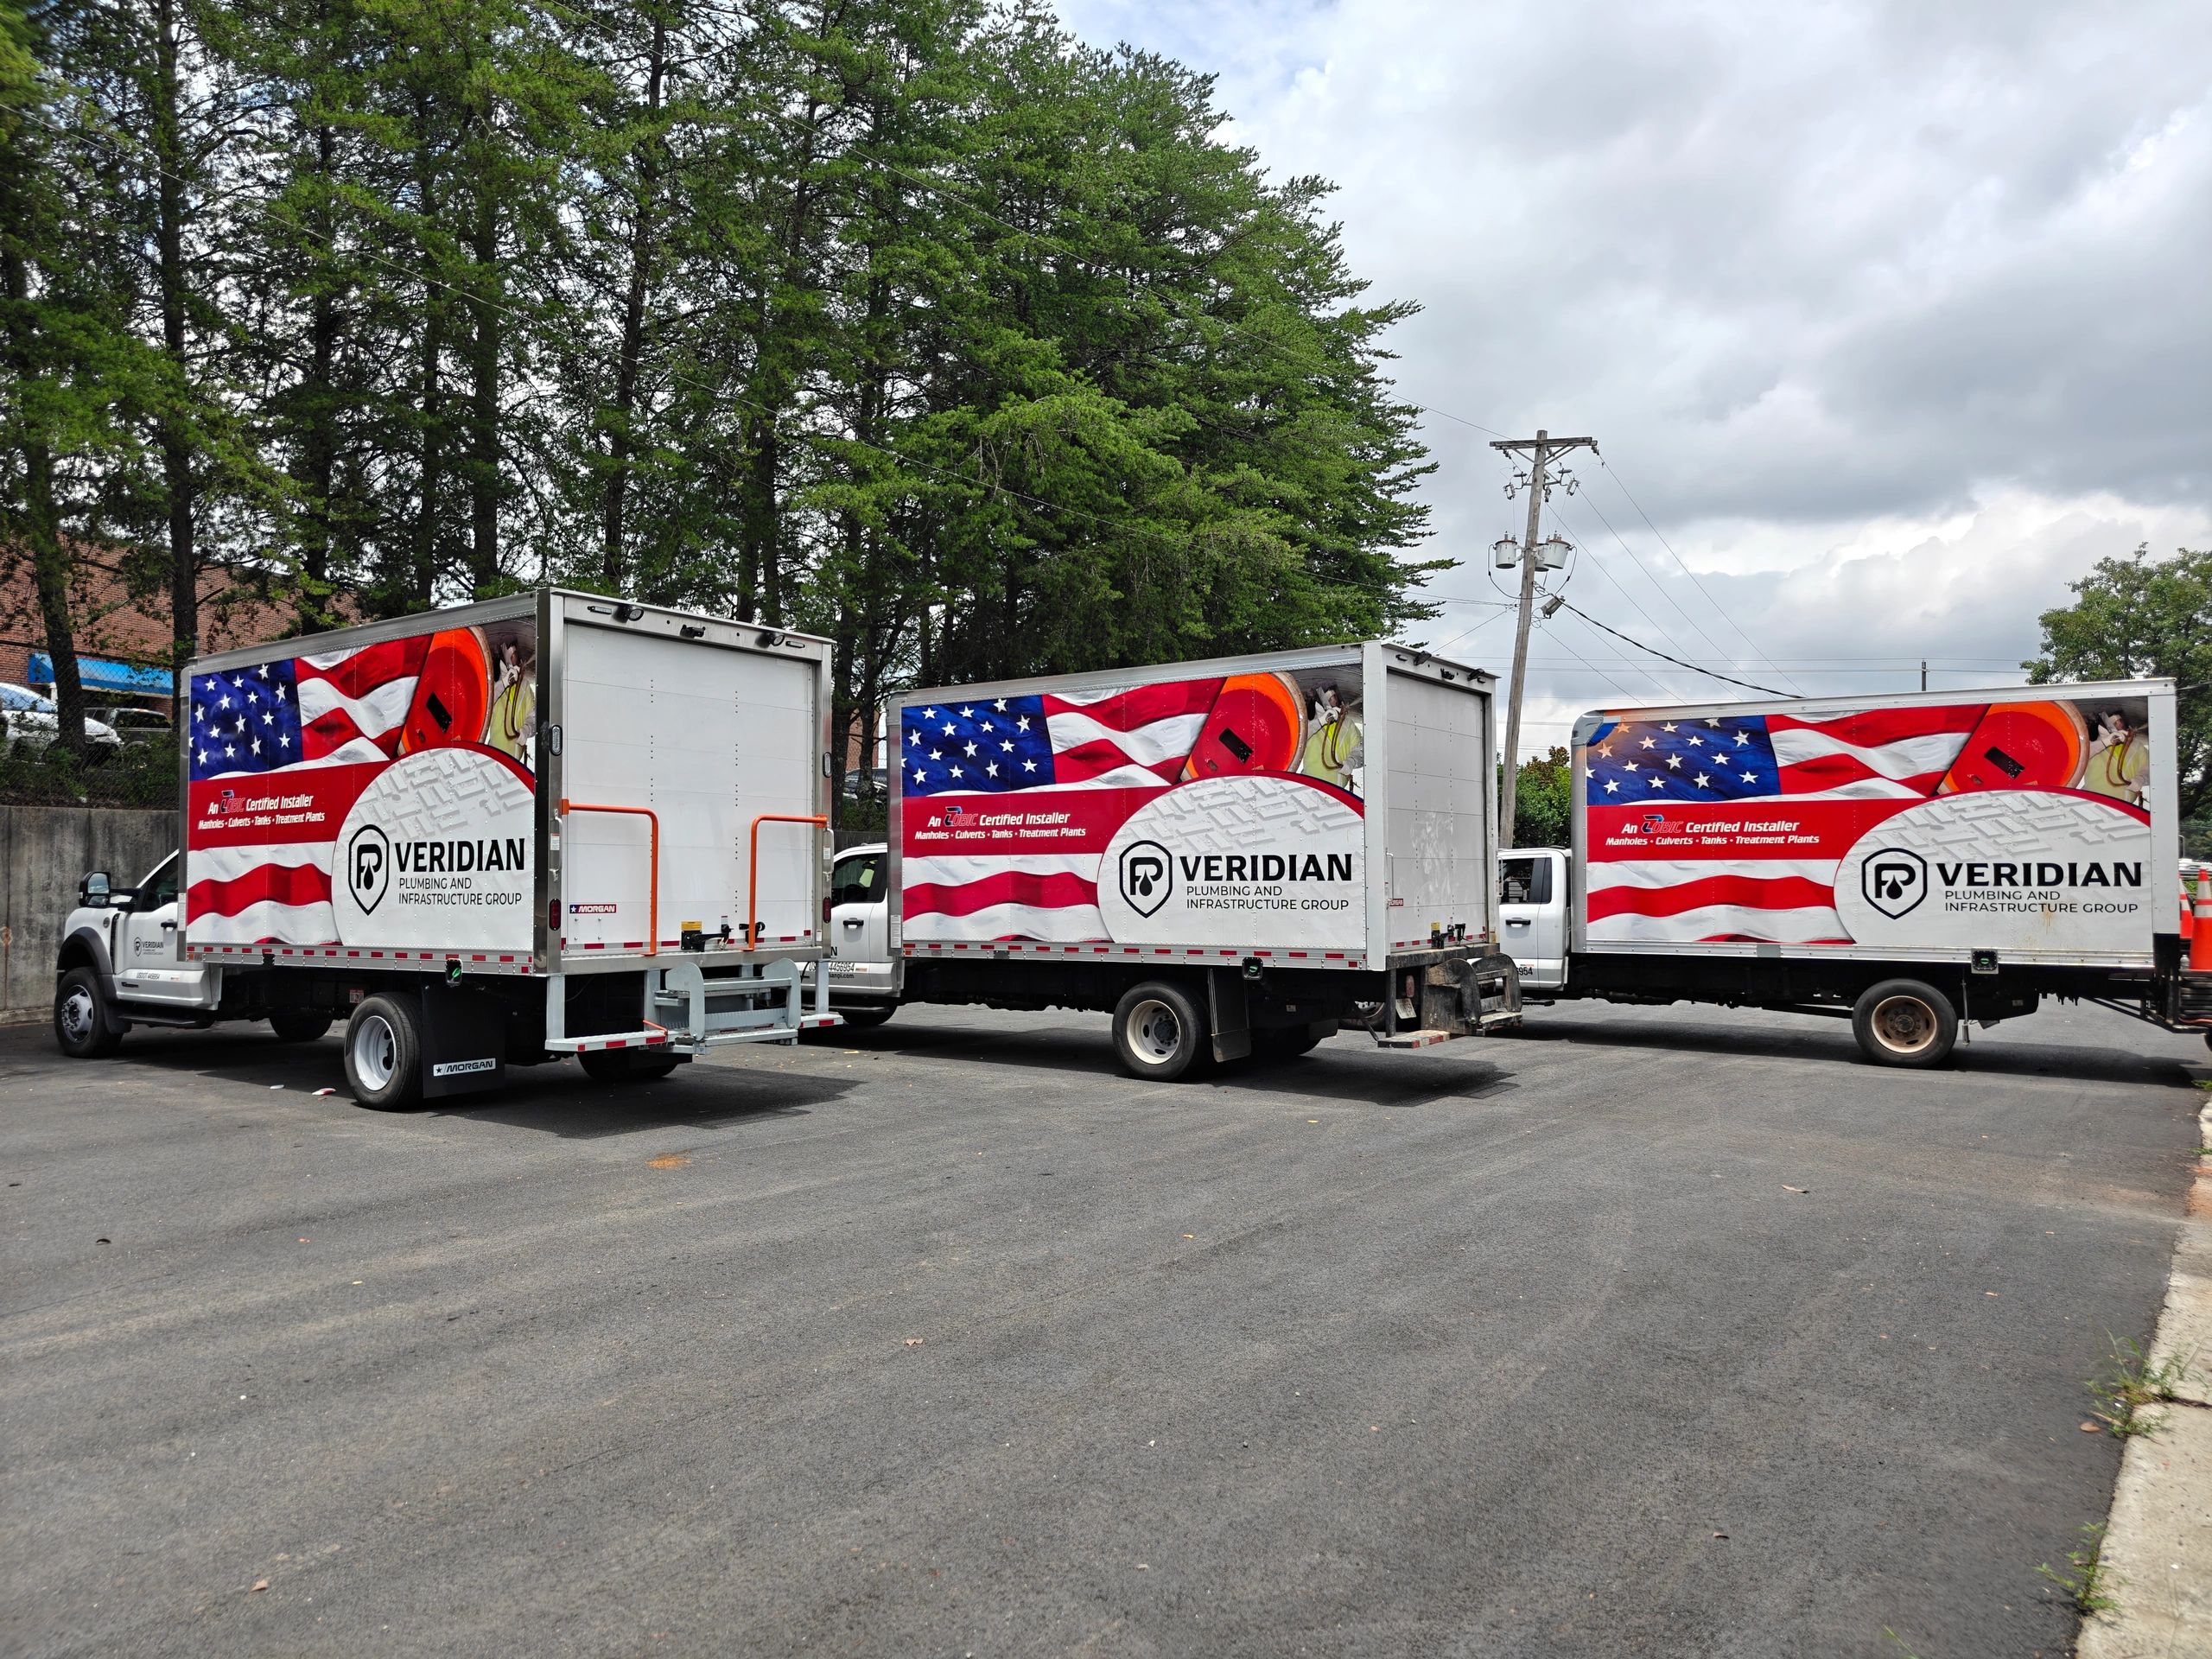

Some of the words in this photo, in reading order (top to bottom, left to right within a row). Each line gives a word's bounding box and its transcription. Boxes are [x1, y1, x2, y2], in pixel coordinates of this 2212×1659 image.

[207, 802, 219, 815] An
[246, 796, 279, 812] Certified
[281, 793, 314, 810] Installer
[198, 820, 225, 830] Manholes
[228, 817, 251, 828] Culverts
[254, 816, 271, 826] Tanks
[276, 813, 304, 824] Treatment
[305, 811, 325, 823] Plants
[928, 816, 941, 828] An
[979, 813, 1023, 826] Certified
[1026, 811, 1071, 825] Installer
[914, 830, 950, 840] Manholes
[955, 830, 986, 840] Culverts
[991, 829, 1013, 839] Tanks
[1019, 828, 1058, 838] Treatment
[1060, 827, 1086, 837] Plants
[1621, 823, 1637, 834] An
[1685, 821, 1740, 833] Certified
[1743, 820, 1800, 832] Installer
[1605, 836, 1648, 846] Manholes
[1656, 836, 1694, 845] Culverts
[1700, 836, 1727, 845] Tanks
[1735, 836, 1785, 844] Treatment
[1787, 835, 1820, 844] Plants
[395, 838, 525, 872] VERIDIAN
[1179, 853, 1352, 881] VERIDIAN
[1936, 861, 2142, 887] VERIDIAN
[399, 878, 448, 889] PLUMBING
[449, 877, 472, 889] AND
[1186, 886, 1250, 896] PLUMBING
[1254, 886, 1282, 896] AND
[1945, 890, 2023, 900] PLUMBING
[2029, 891, 2061, 900] AND
[398, 893, 482, 906] INFRASTRUCTURE
[486, 893, 522, 906] GROUP
[1186, 899, 1297, 910] INFRASTRUCTURE
[1300, 899, 1350, 911] GROUP
[1945, 902, 2078, 913] INFRASTRUCTURE
[2082, 903, 2139, 913] GROUP
[446, 1060, 493, 1073] MORGAN
